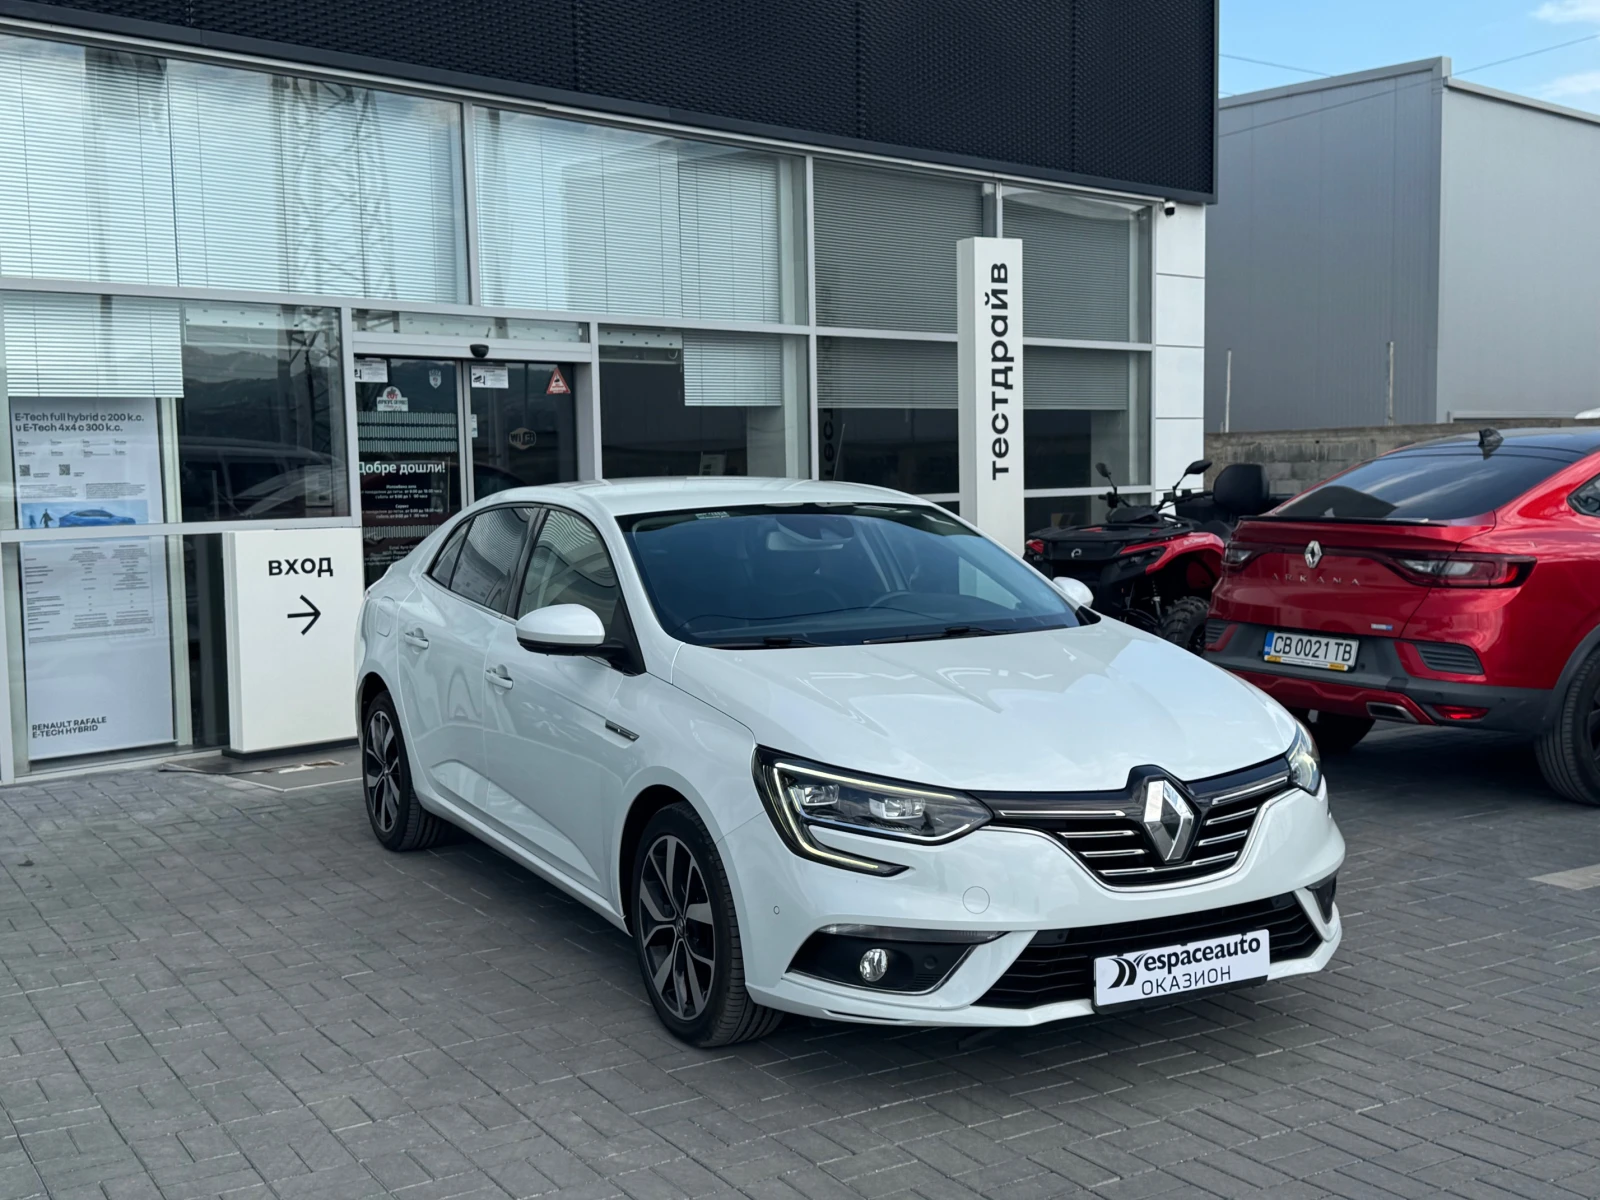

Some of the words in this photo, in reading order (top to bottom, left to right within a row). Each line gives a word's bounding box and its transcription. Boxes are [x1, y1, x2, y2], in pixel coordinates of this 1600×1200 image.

[985, 263, 1014, 480] тестдрайв
[15, 412, 49, 421] E-Tech
[50, 412, 66, 421] full
[67, 412, 99, 424] hybrid
[107, 413, 127, 421] 200
[23, 423, 57, 432] E-Tech
[58, 423, 77, 432] 4x4
[86, 423, 105, 432] 300
[358, 461, 397, 477] Добре
[399, 461, 446, 475] дошли!
[1273, 572, 1360, 585] ARKANA
[1273, 635, 1292, 654] CB
[1295, 637, 1330, 660] 0021
[1335, 642, 1353, 662] TB
[32, 720, 72, 731] RENAULT
[73, 716, 107, 726] RAFALE
[32, 728, 65, 738] E-TECH
[65, 725, 98, 735] HYBRID
[1144, 936, 1261, 974] espaceauto
[1142, 966, 1231, 996] ОКАЗИОН
